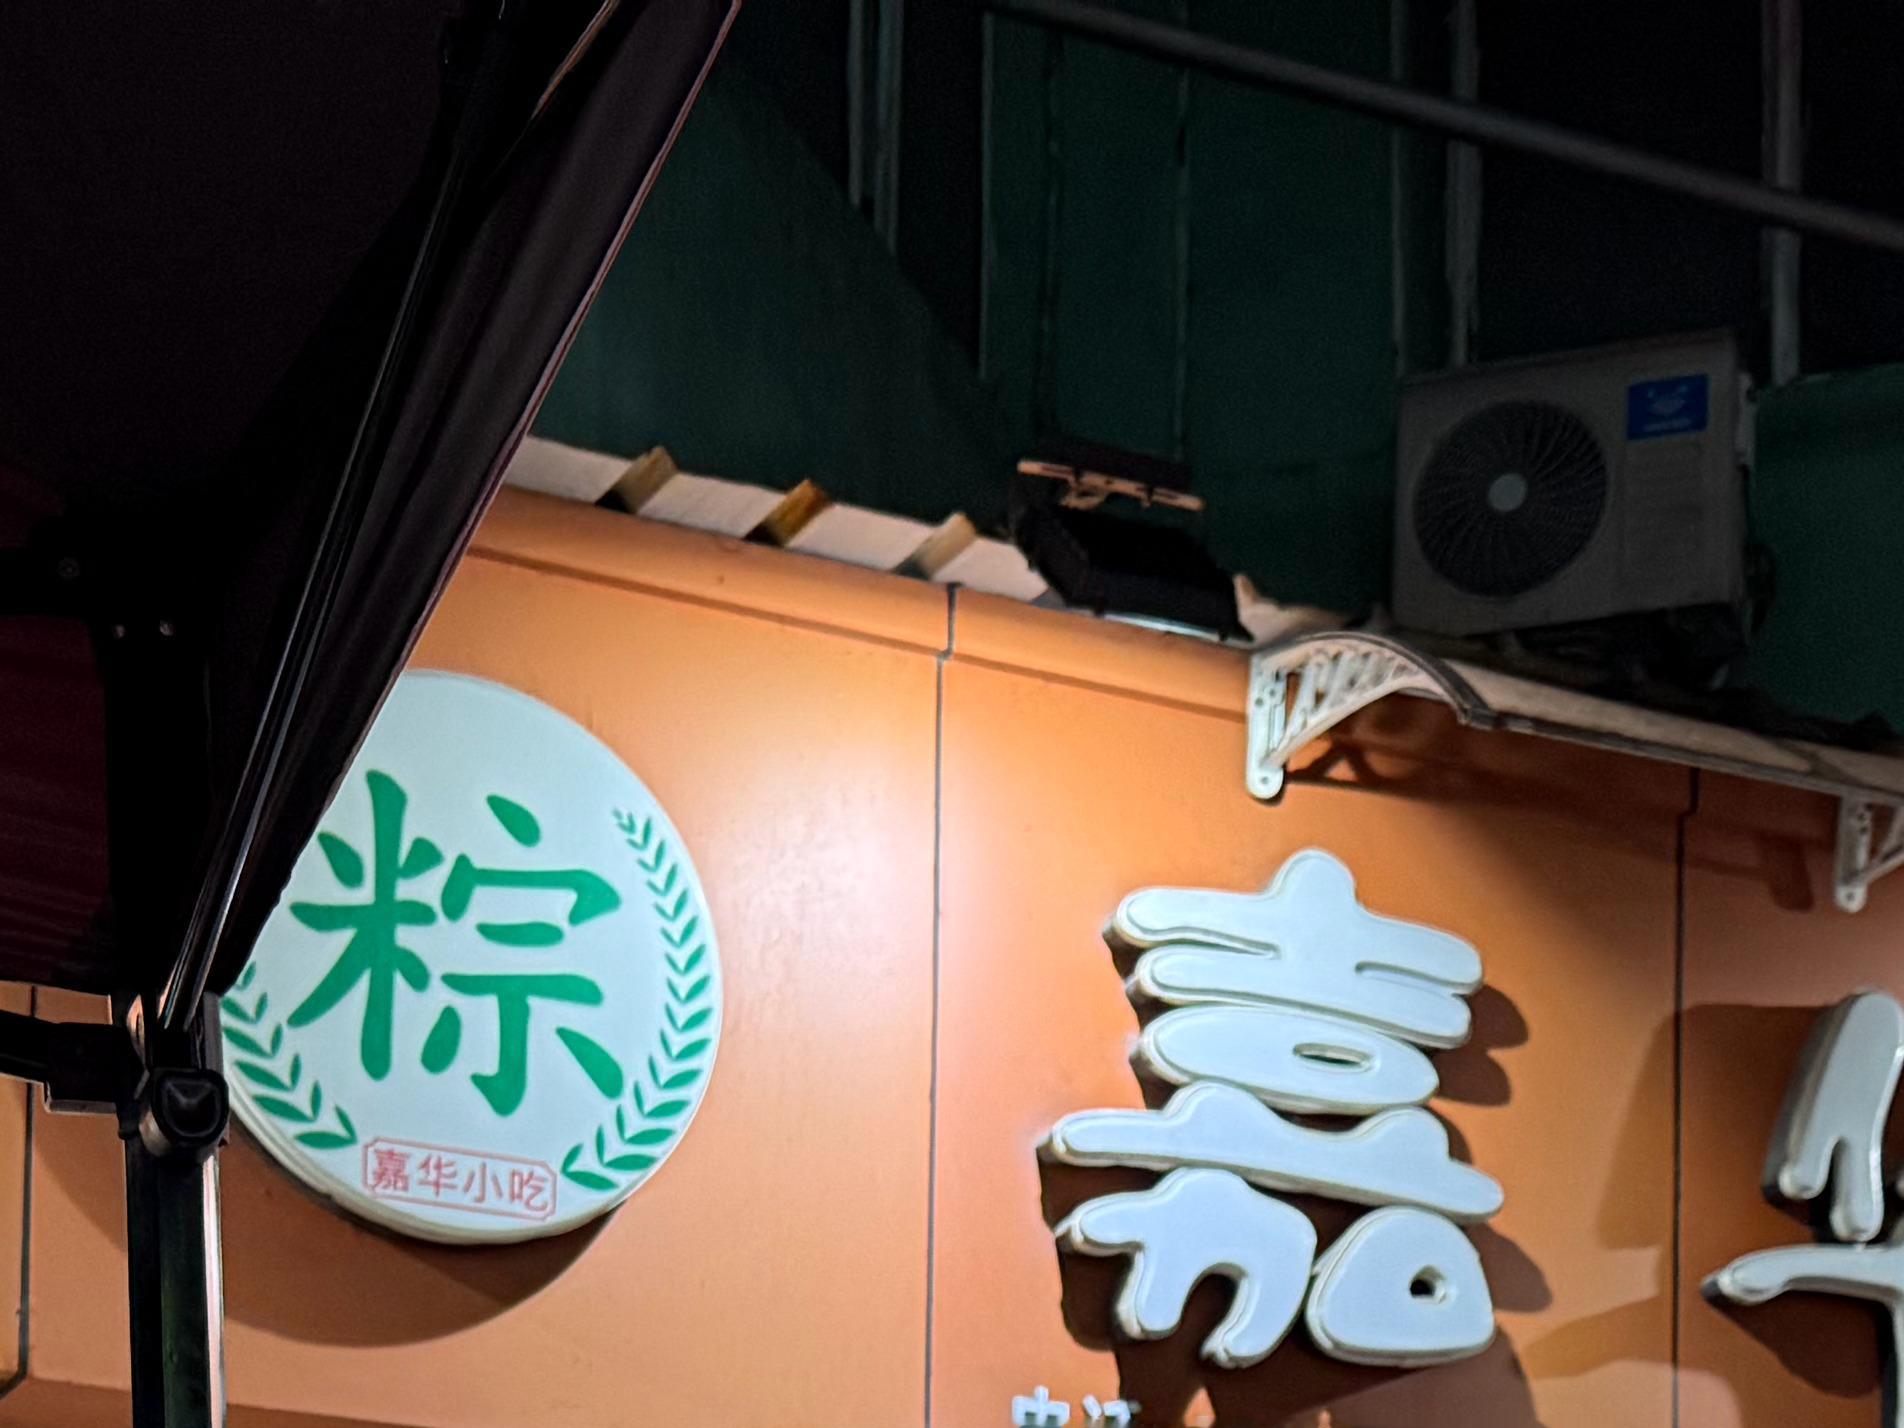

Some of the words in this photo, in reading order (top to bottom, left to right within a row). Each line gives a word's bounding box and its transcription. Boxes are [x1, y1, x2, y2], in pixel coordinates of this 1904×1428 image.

[286, 768, 623, 1117] 粽
[370, 1145, 551, 1213] 嘉华小吃
